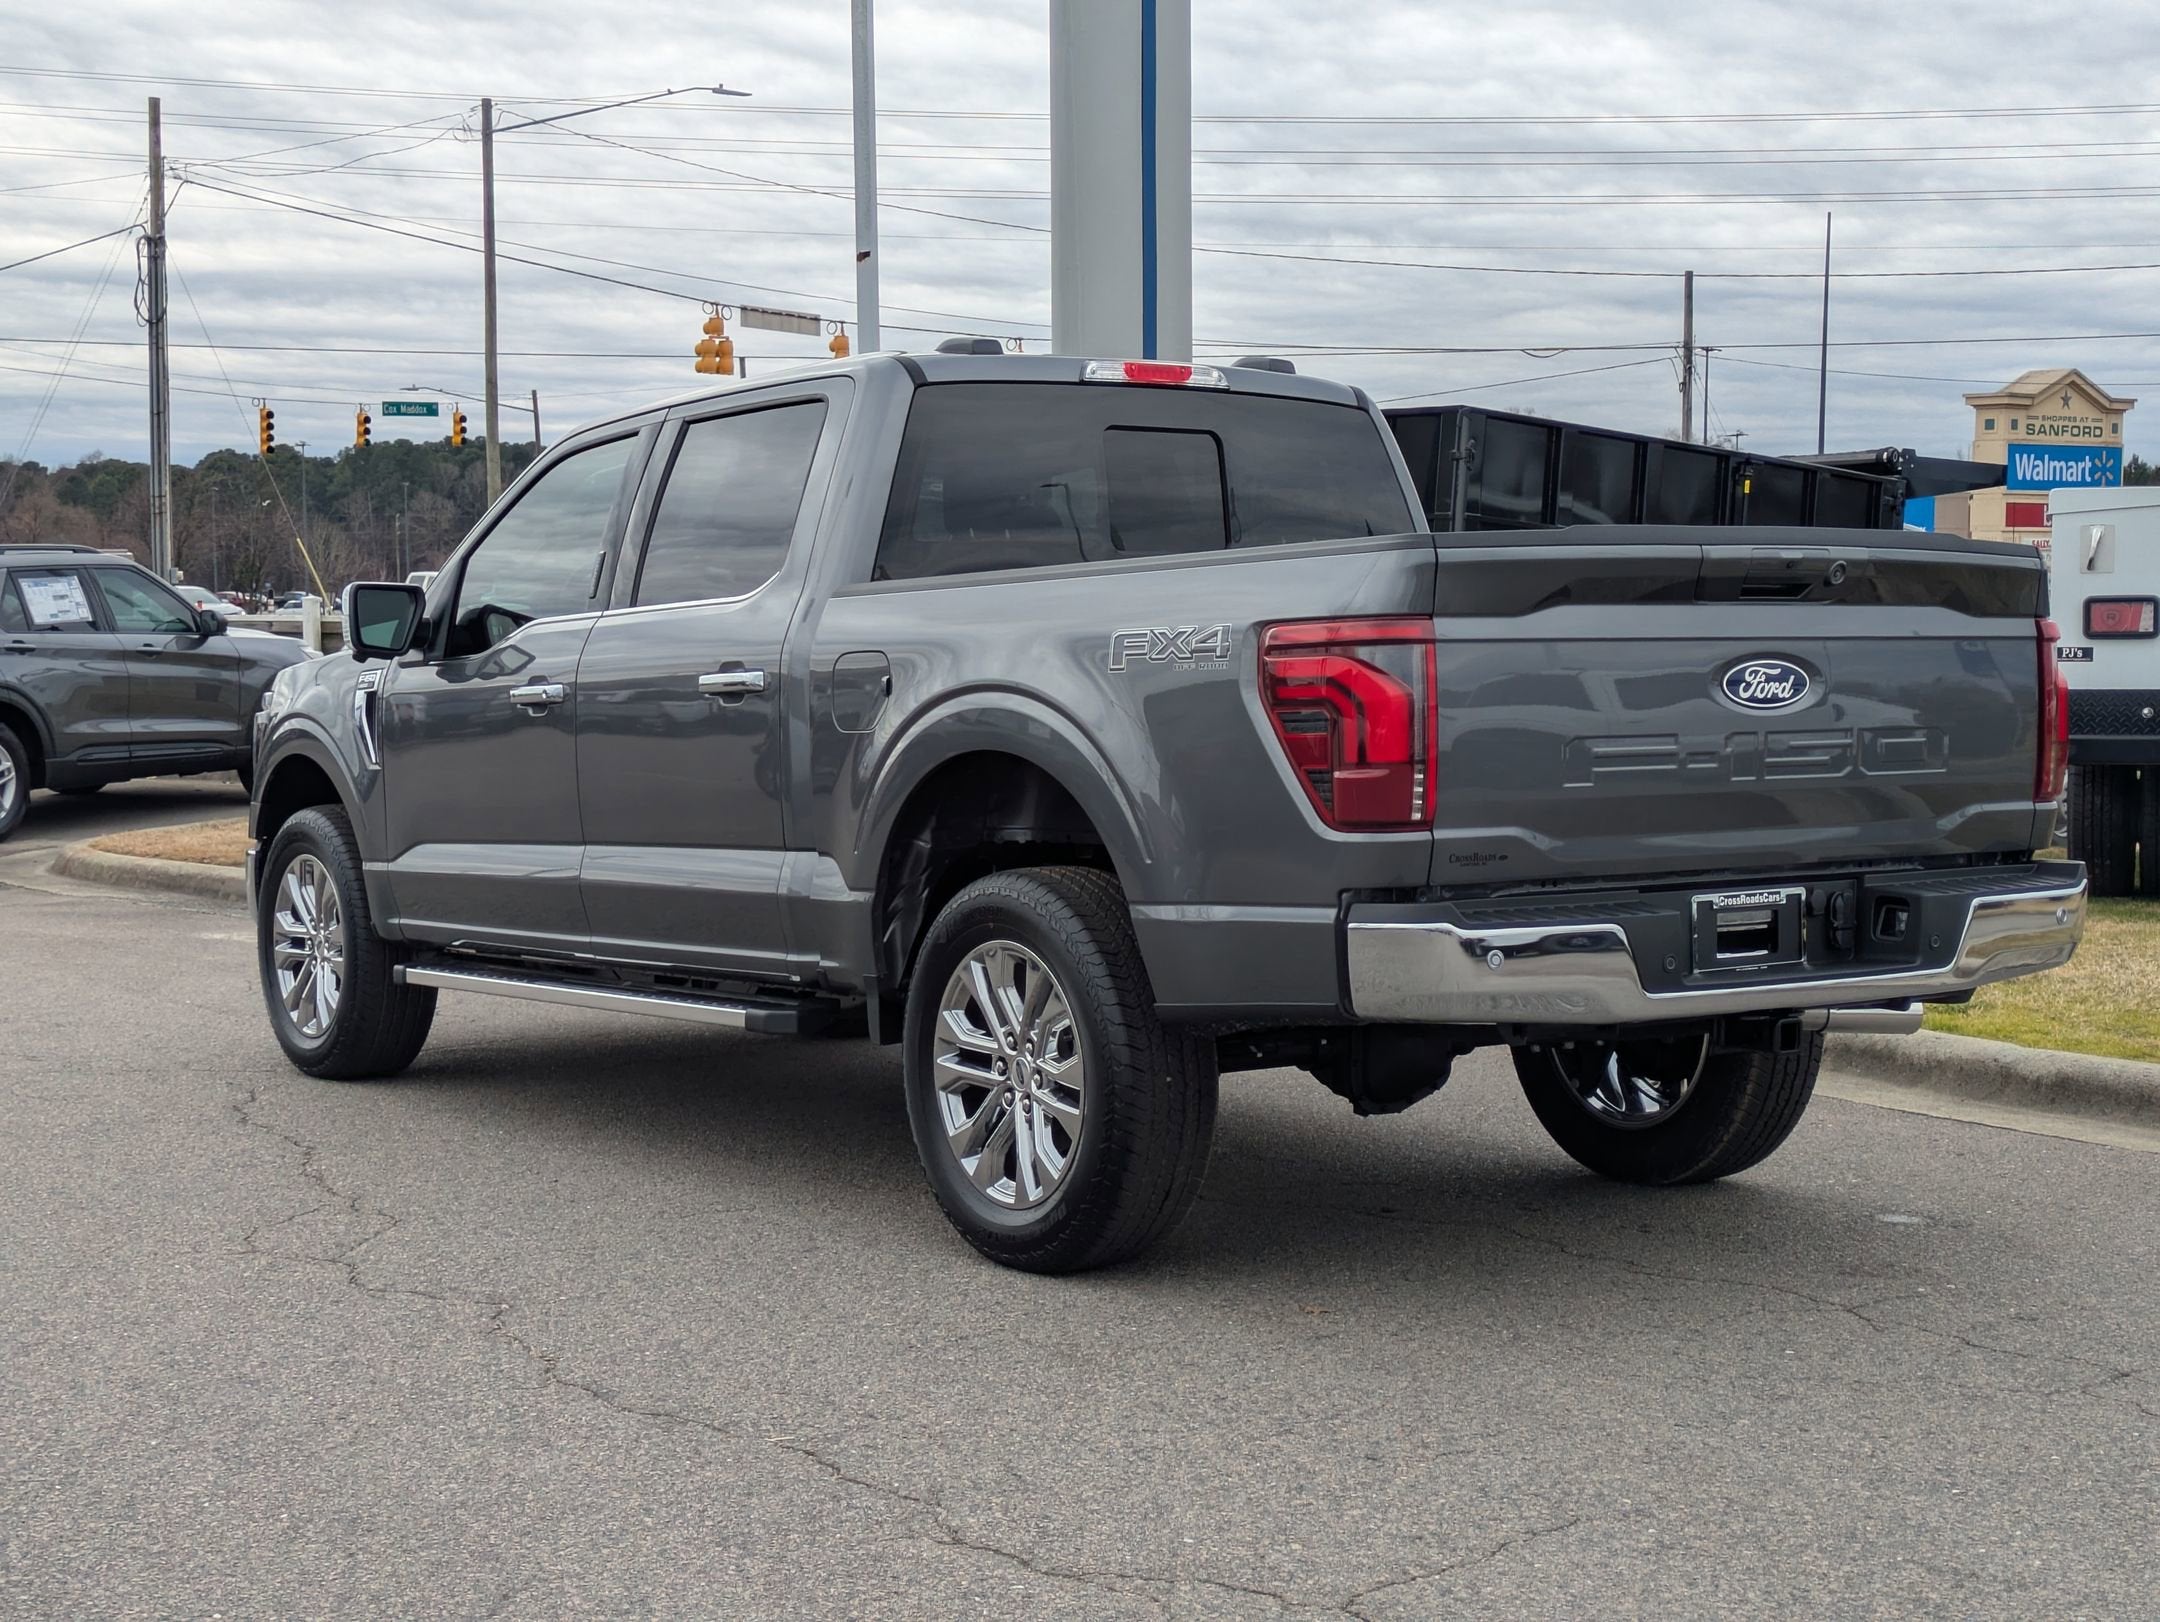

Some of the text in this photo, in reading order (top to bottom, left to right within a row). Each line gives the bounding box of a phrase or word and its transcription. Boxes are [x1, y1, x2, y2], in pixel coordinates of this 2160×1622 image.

[383, 404, 397, 414] Cox
[400, 403, 427, 414] Maddox
[2041, 414, 2077, 422] SHOPPES
[2025, 423, 2103, 438] SANFORD
[2014, 453, 2092, 482] Walmart
[1108, 623, 1232, 673] FX4
[2062, 647, 2083, 658] PJ's
[1739, 666, 1796, 699] Ford
[1562, 726, 1950, 787] F-150
[1720, 892, 1781, 906] CrossRoadsCars
